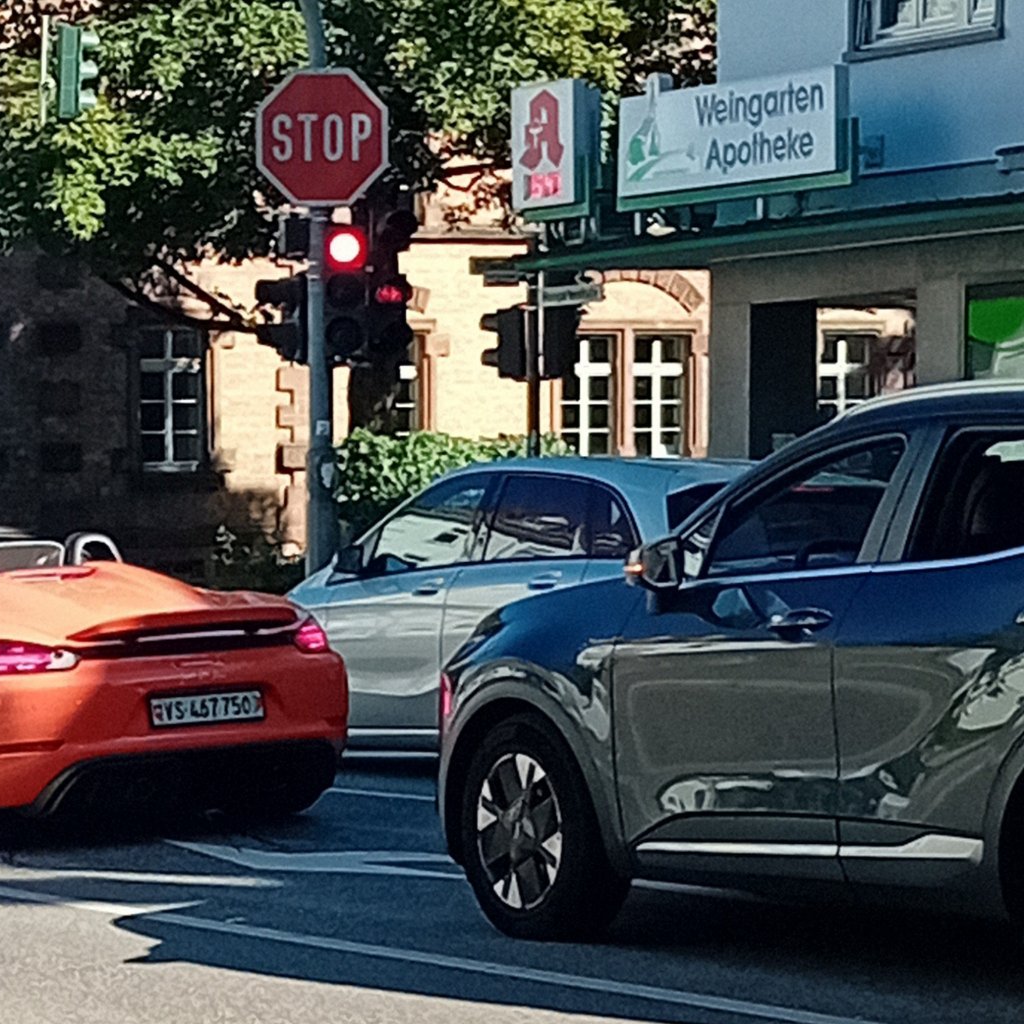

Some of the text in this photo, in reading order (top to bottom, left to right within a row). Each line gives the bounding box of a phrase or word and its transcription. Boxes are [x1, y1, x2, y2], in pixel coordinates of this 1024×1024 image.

[695, 82, 824, 127] Weingarten
[272, 112, 373, 162] STOP
[705, 129, 814, 174] Apotheke
